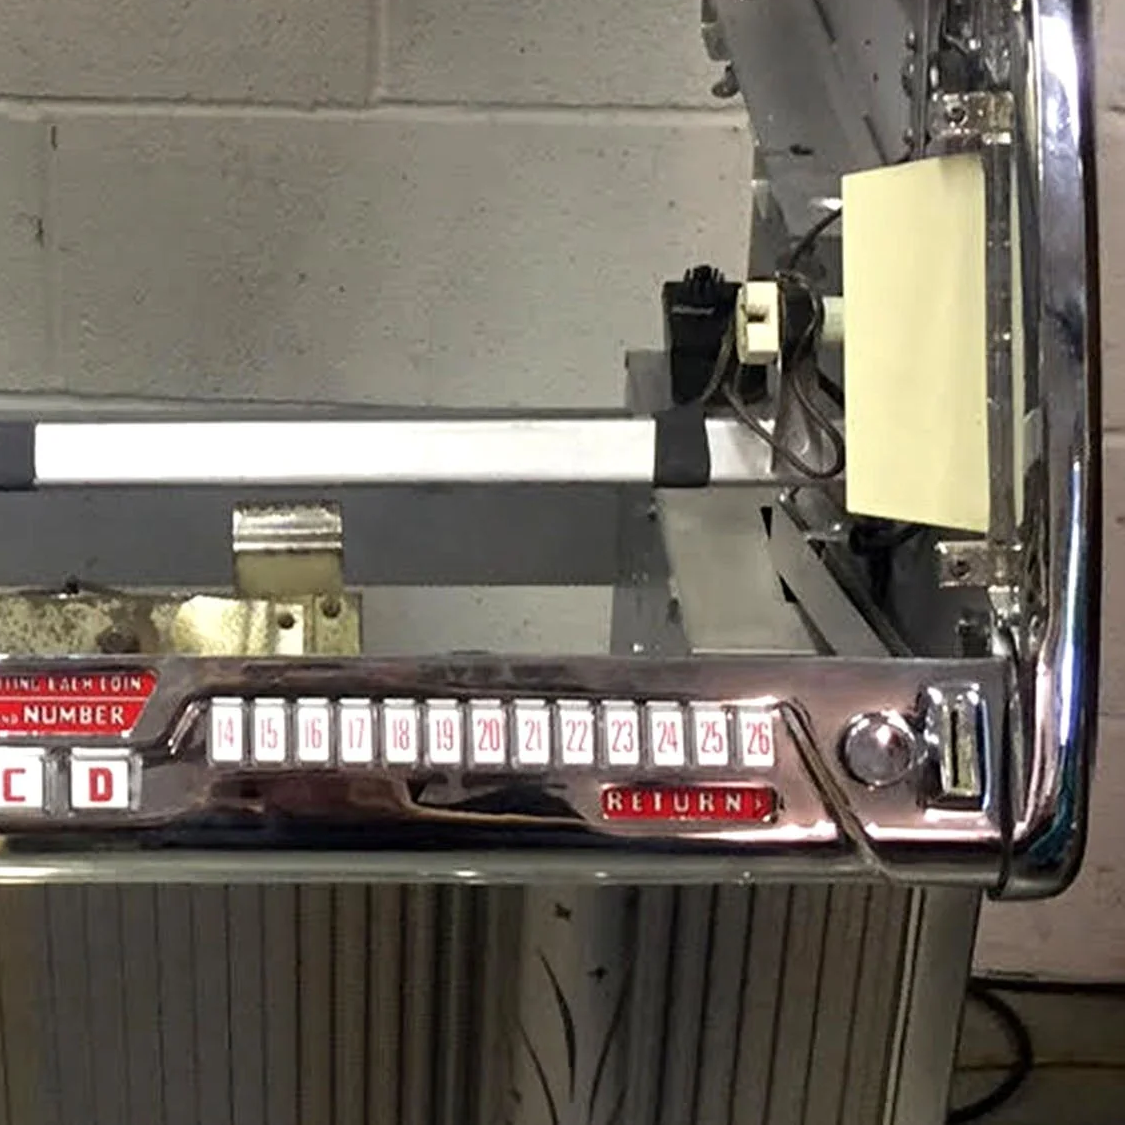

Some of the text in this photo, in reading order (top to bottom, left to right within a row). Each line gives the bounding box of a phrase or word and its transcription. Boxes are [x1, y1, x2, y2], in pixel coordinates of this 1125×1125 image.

[99, 675, 142, 691] COIN
[24, 704, 125, 725] NUMBER
[216, 717, 770, 755] 14 15 16 17 18 19 20 21 22 23 24 25 26
[2, 768, 27, 803] C
[88, 767, 115, 803] D
[606, 791, 742, 812] RETURN
